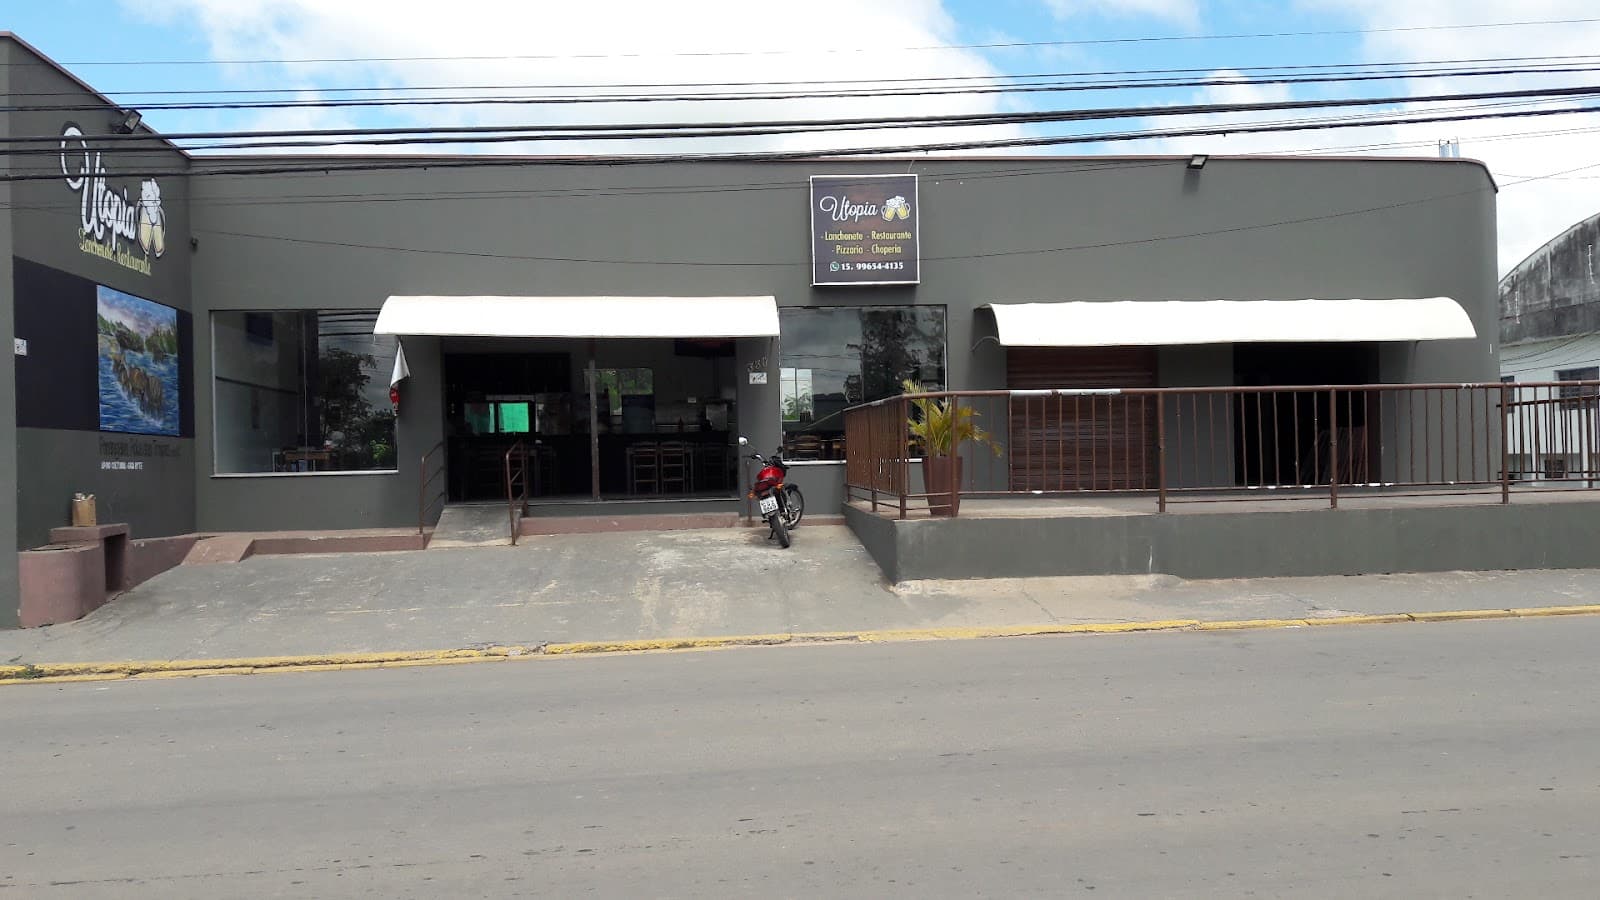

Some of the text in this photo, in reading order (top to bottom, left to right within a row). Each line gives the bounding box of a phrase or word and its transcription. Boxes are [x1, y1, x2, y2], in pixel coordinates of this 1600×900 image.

[61, 127, 136, 251] Utopia
[820, 196, 878, 222] Utopia
[871, 230, 912, 240] Restaurante
[871, 244, 902, 255] Choperia
[856, 262, 904, 270] 99654-4135
